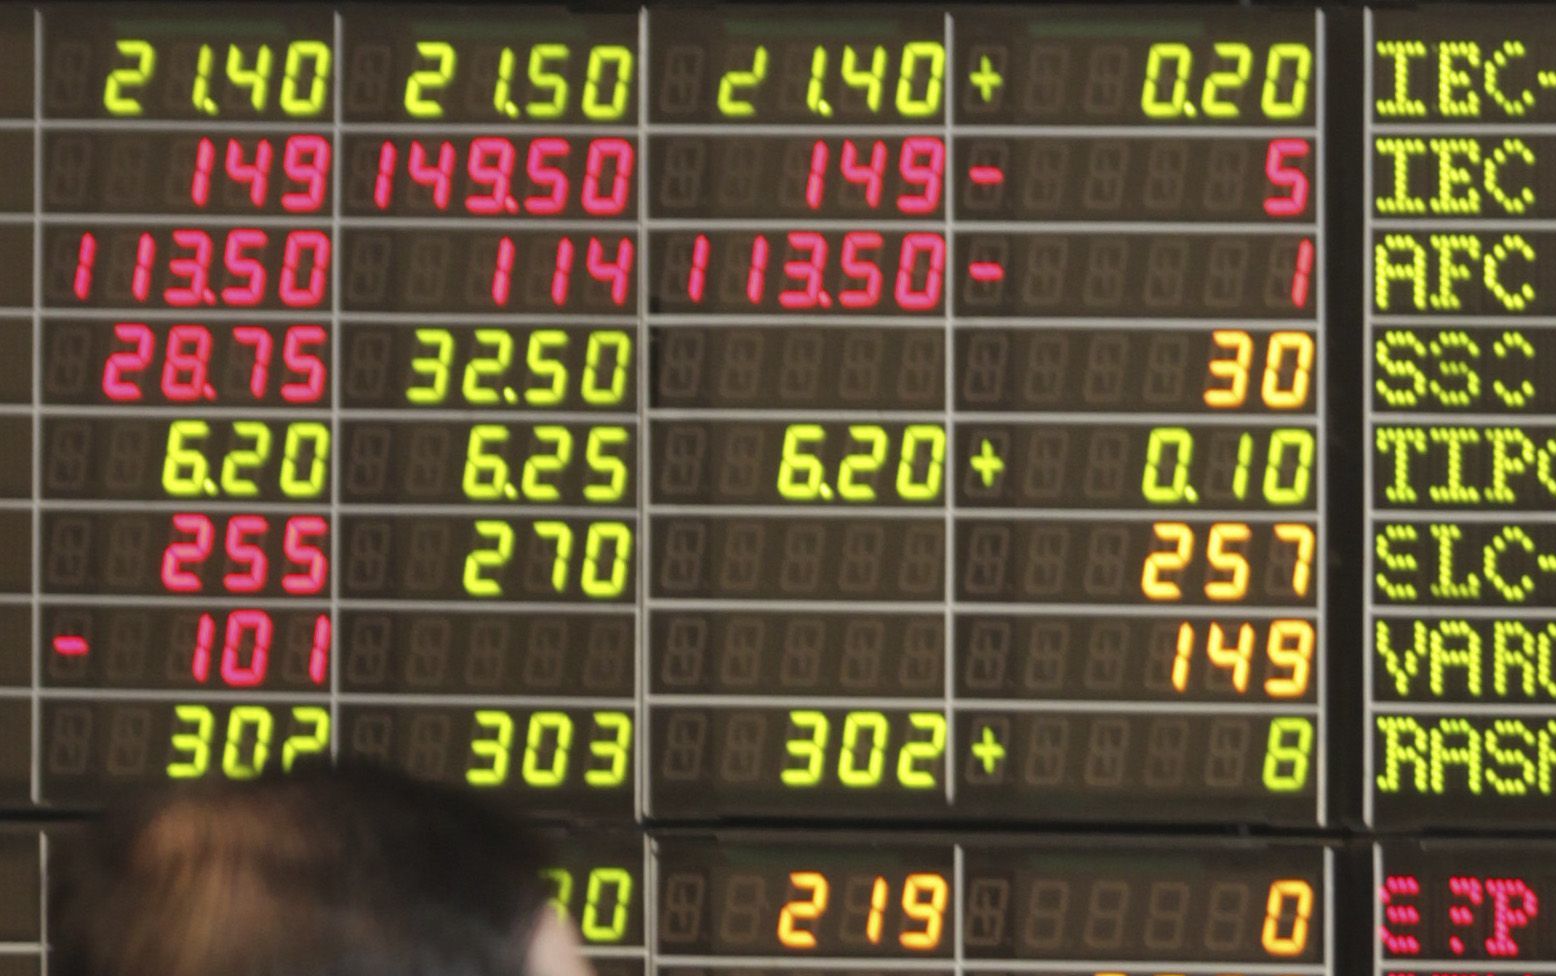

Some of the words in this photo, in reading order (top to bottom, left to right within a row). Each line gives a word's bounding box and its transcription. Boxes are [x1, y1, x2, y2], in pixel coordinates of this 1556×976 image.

[104, 40, 331, 115] 21.40
[404, 42, 633, 119] 21.50
[1141, 43, 1312, 118] 0.20
[191, 134, 332, 213] 149
[374, 136, 635, 216] 149.50
[806, 135, 946, 215] 149
[1263, 138, 1310, 217] 5
[1376, 138, 1535, 213] IEC
[74, 227, 332, 307] 113.50
[492, 236, 634, 306] 114
[688, 230, 946, 311] 113.50
[1291, 238, 1314, 308] 1
[1375, 235, 1535, 310] AFC
[102, 322, 327, 403] 28.75
[406, 329, 631, 405] 32.50
[1203, 328, 1315, 410] 30
[162, 420, 330, 497] 6.20
[463, 425, 628, 501] 6.25
[777, 424, 946, 500] 6.20
[1142, 428, 1314, 505] 0.10
[161, 512, 328, 594] 255
[463, 521, 632, 597] 270
[1141, 520, 1316, 601] 257
[191, 608, 332, 687] 101
[1171, 617, 1317, 698] 149
[167, 705, 331, 778] 302
[466, 711, 632, 786] 303
[781, 711, 946, 788] 302
[1263, 717, 1313, 791] 8
[777, 871, 949, 950] 219
[1261, 880, 1314, 956] 0
